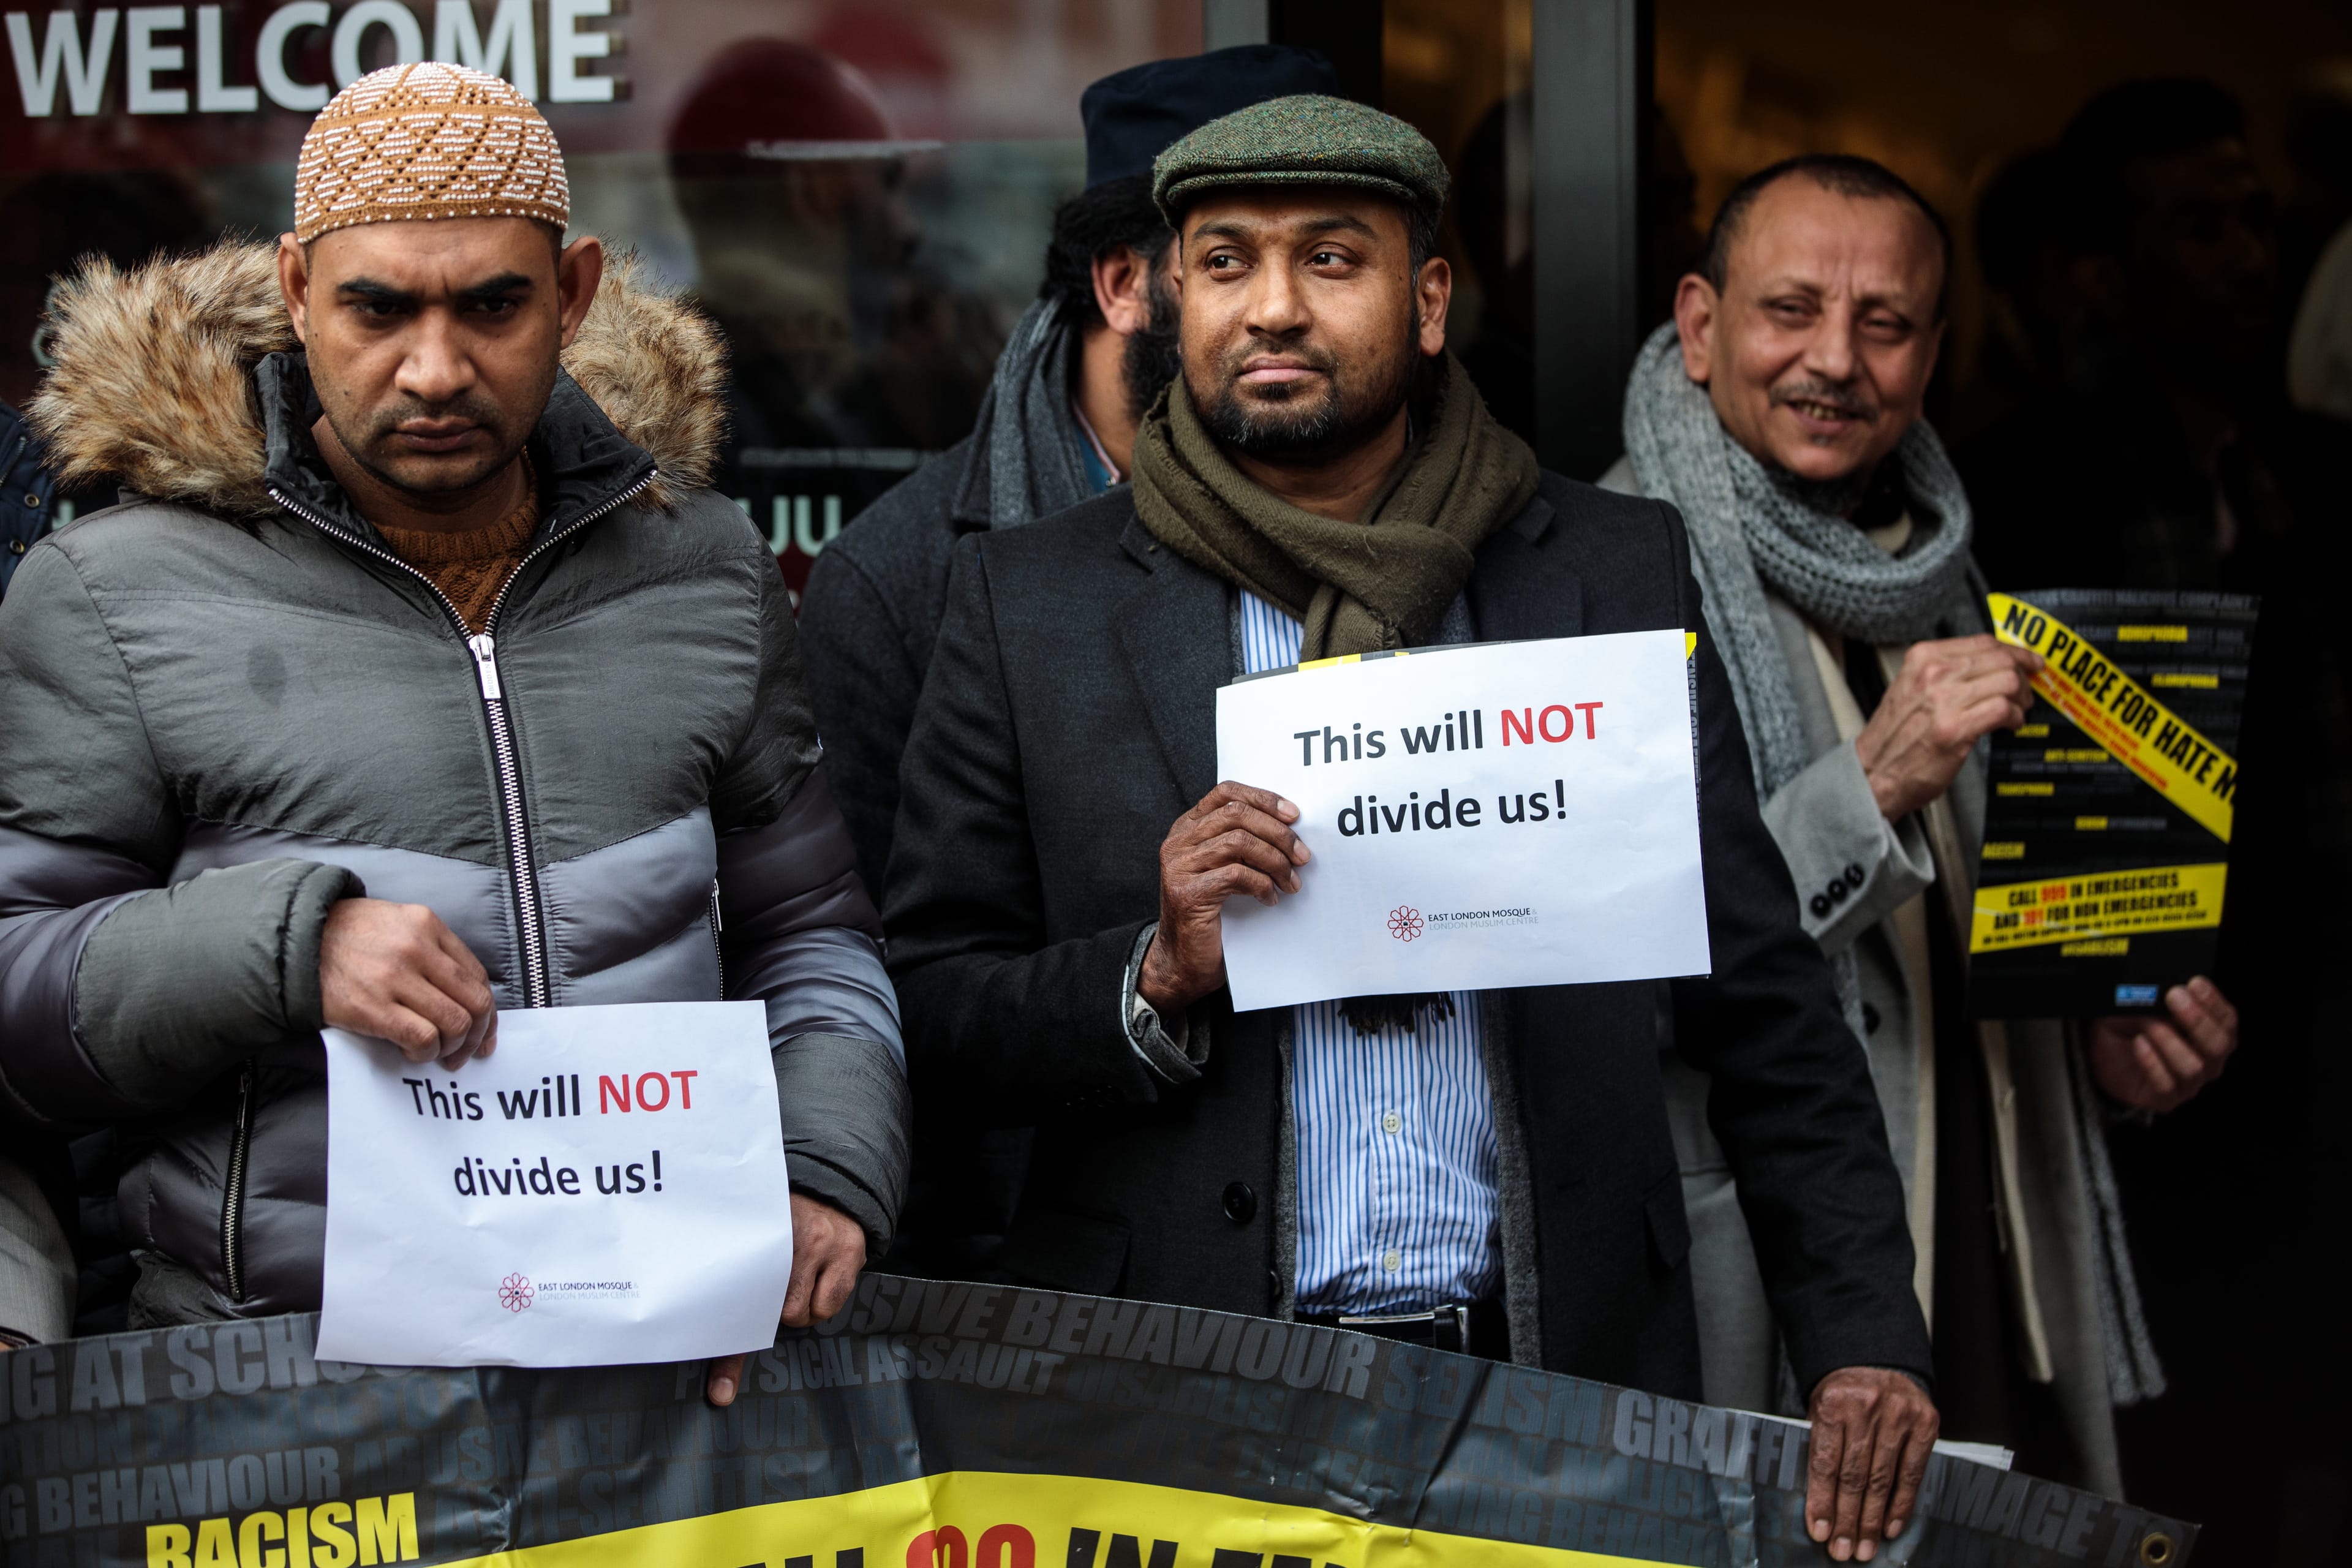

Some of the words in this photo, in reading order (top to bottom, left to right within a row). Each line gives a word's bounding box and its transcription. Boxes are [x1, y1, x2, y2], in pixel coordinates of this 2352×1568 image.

[5, 0, 616, 116] WELCOME
[2003, 604, 2046, 647] NO
[2046, 628, 2119, 704] PLACE
[2110, 685, 2159, 739] FOR
[2153, 718, 2219, 786] HATE
[1294, 723, 1385, 766] This
[1401, 710, 1482, 754] will
[1502, 702, 1603, 746] NOT
[1338, 789, 1480, 837] divide
[1499, 780, 1566, 823] us!
[1428, 913, 1449, 922] EAST
[1451, 911, 1490, 921] LONDON
[1493, 908, 1531, 918] MOSQUE
[1994, 913, 2019, 929] AND
[2047, 905, 2070, 922] FOR
[2103, 890, 2198, 914] EMERGENCIES
[2008, 889, 2037, 907] CALL
[2087, 872, 2179, 895] EMERGENCIES
[1429, 921, 1468, 930] LONDON
[1471, 919, 1504, 928] MUSLIM
[1507, 916, 1539, 925] CENTRE
[402, 1077, 484, 1121] This
[497, 1074, 580, 1120] will
[600, 1071, 697, 1114] NOT
[454, 1157, 580, 1196] divide
[595, 1150, 662, 1194] us!
[539, 1292, 576, 1301] LONDON
[610, 1291, 641, 1299] CENTRE
[559, 1282, 595, 1291] LONDON
[597, 1281, 632, 1291] MOSQUE
[70, 1335, 153, 1411] AT
[167, 1316, 413, 1401] SCH
[674, 1338, 862, 1400] PYSICAL
[868, 1335, 1066, 1396] ASSAULT
[1003, 1287, 1378, 1400] BEHAVIOUR
[1613, 1388, 1810, 1492] GRAFFI
[1916, 1452, 2107, 1559] AMAGE
[37, 1446, 341, 1534] BEHAVIOUR
[146, 1492, 420, 1568] RACISM
